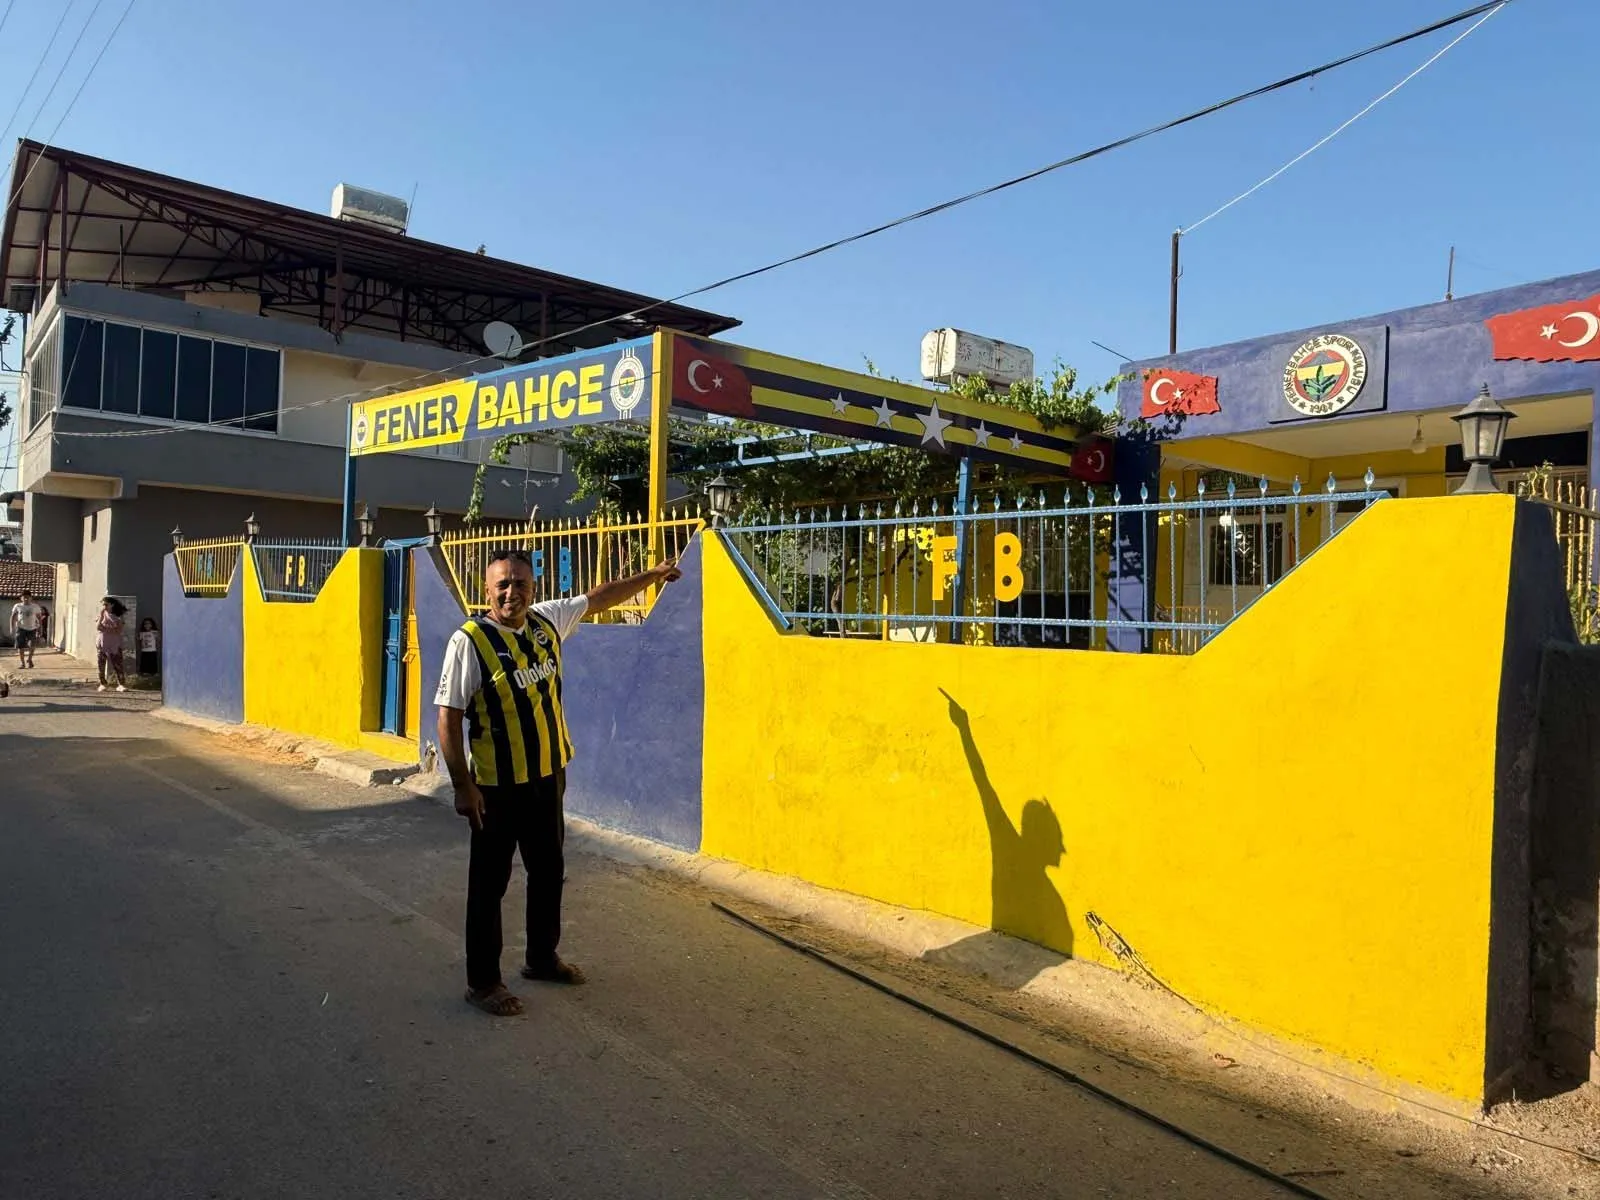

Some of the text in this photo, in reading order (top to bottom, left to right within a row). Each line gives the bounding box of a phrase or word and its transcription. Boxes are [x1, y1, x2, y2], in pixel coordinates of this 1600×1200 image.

[1322, 336, 1355, 352] SPOR
[373, 394, 459, 446] FENER
[477, 364, 605, 430] BAHCE
